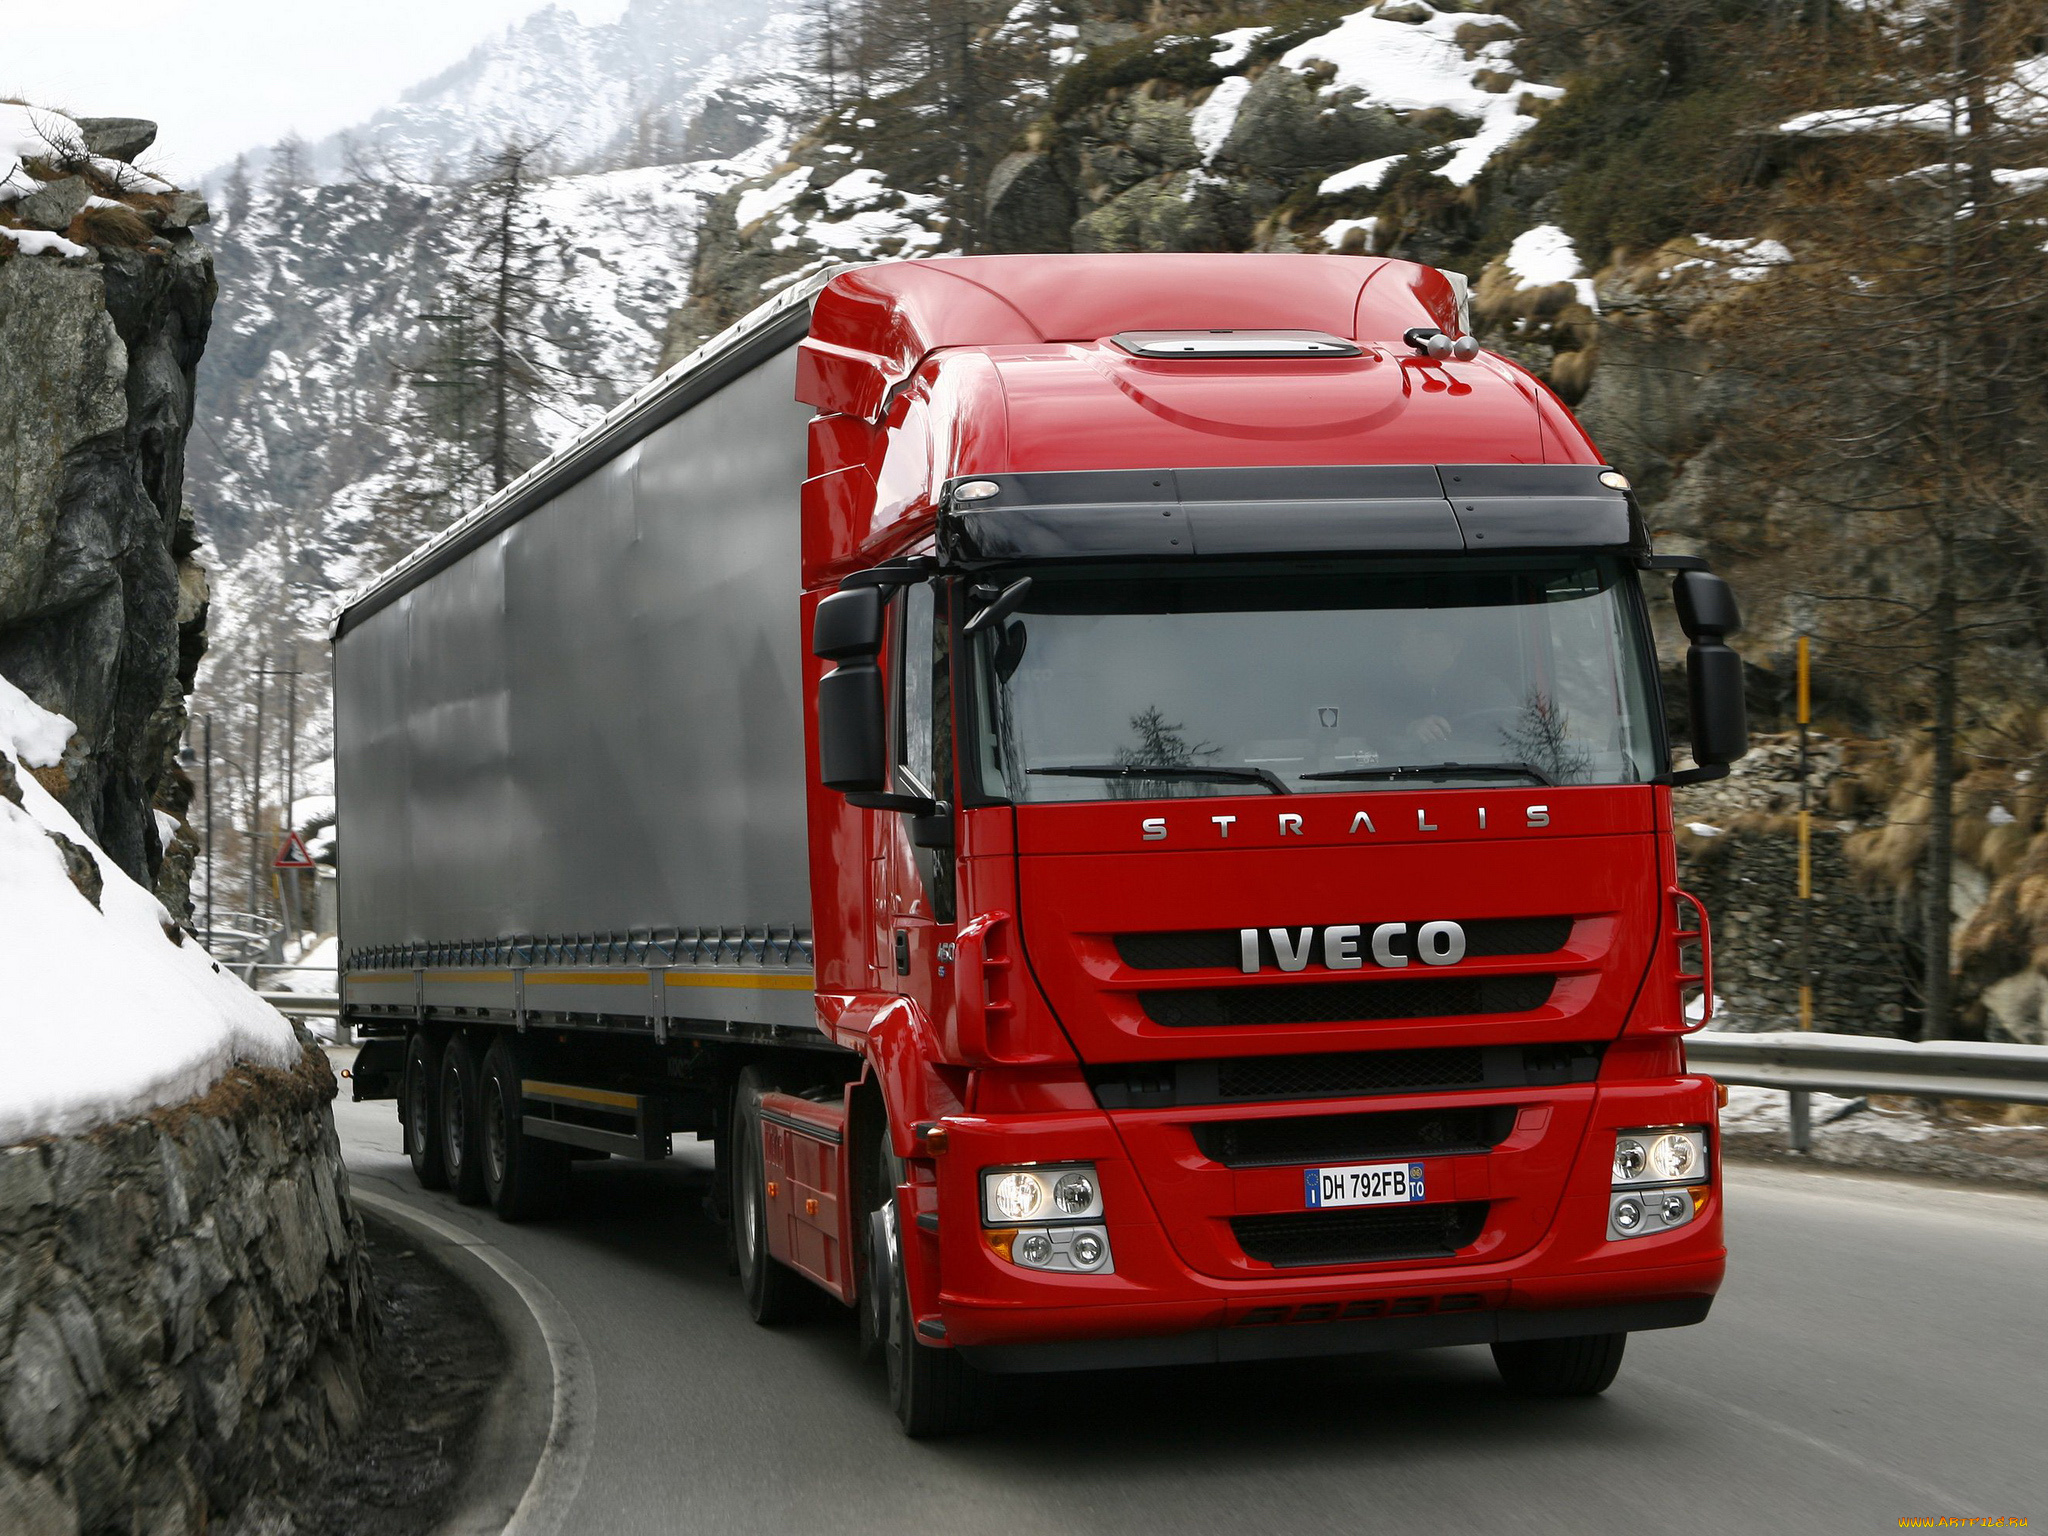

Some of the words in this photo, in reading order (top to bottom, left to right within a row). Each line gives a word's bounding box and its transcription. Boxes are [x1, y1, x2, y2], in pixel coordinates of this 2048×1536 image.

[1142, 805, 1550, 841] STRALIS
[1240, 920, 1467, 974] IVECO
[1311, 1189, 1316, 1204] I
[1322, 1175, 1345, 1200] DH
[1350, 1171, 1407, 1198] 792FB
[1409, 1181, 1425, 1198] TO
